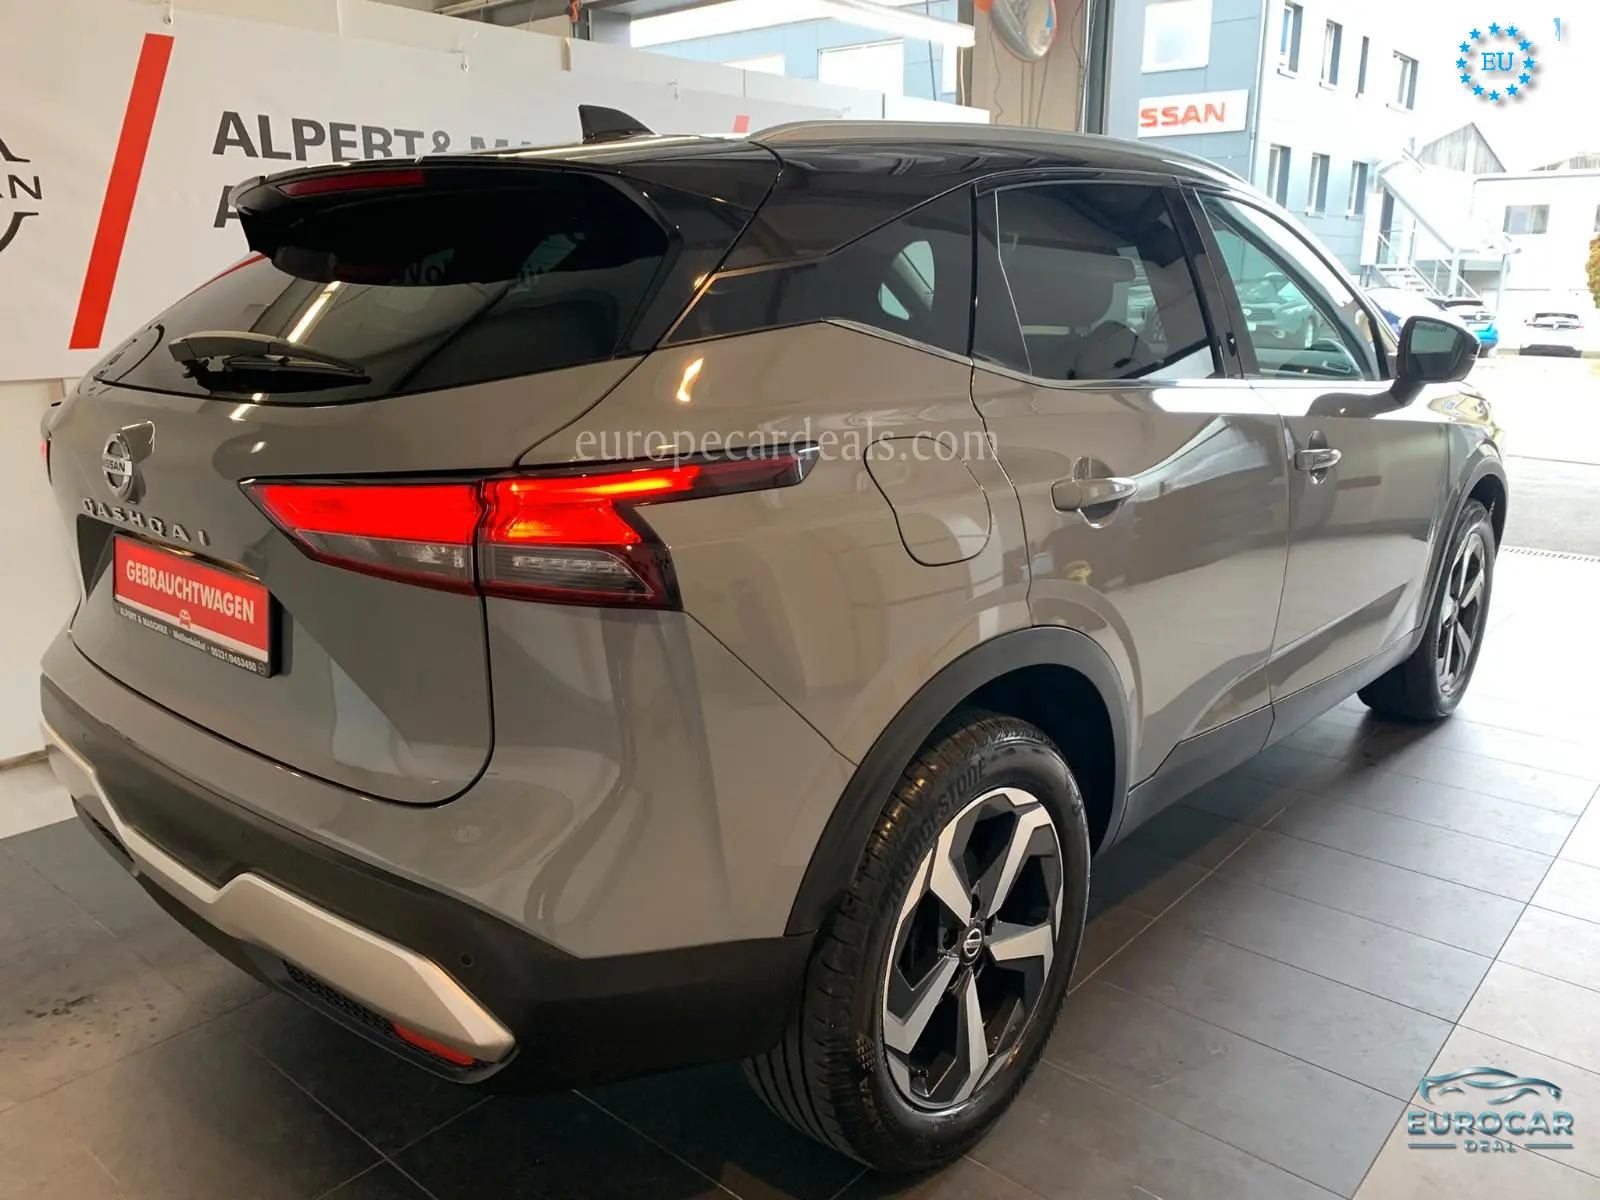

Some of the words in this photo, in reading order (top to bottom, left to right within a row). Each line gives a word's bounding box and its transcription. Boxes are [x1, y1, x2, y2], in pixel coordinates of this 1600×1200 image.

[0, 174, 43, 200] N
[82, 498, 210, 547] QASHQAI
[126, 560, 255, 624] GEBRAUCHTWAGEN
